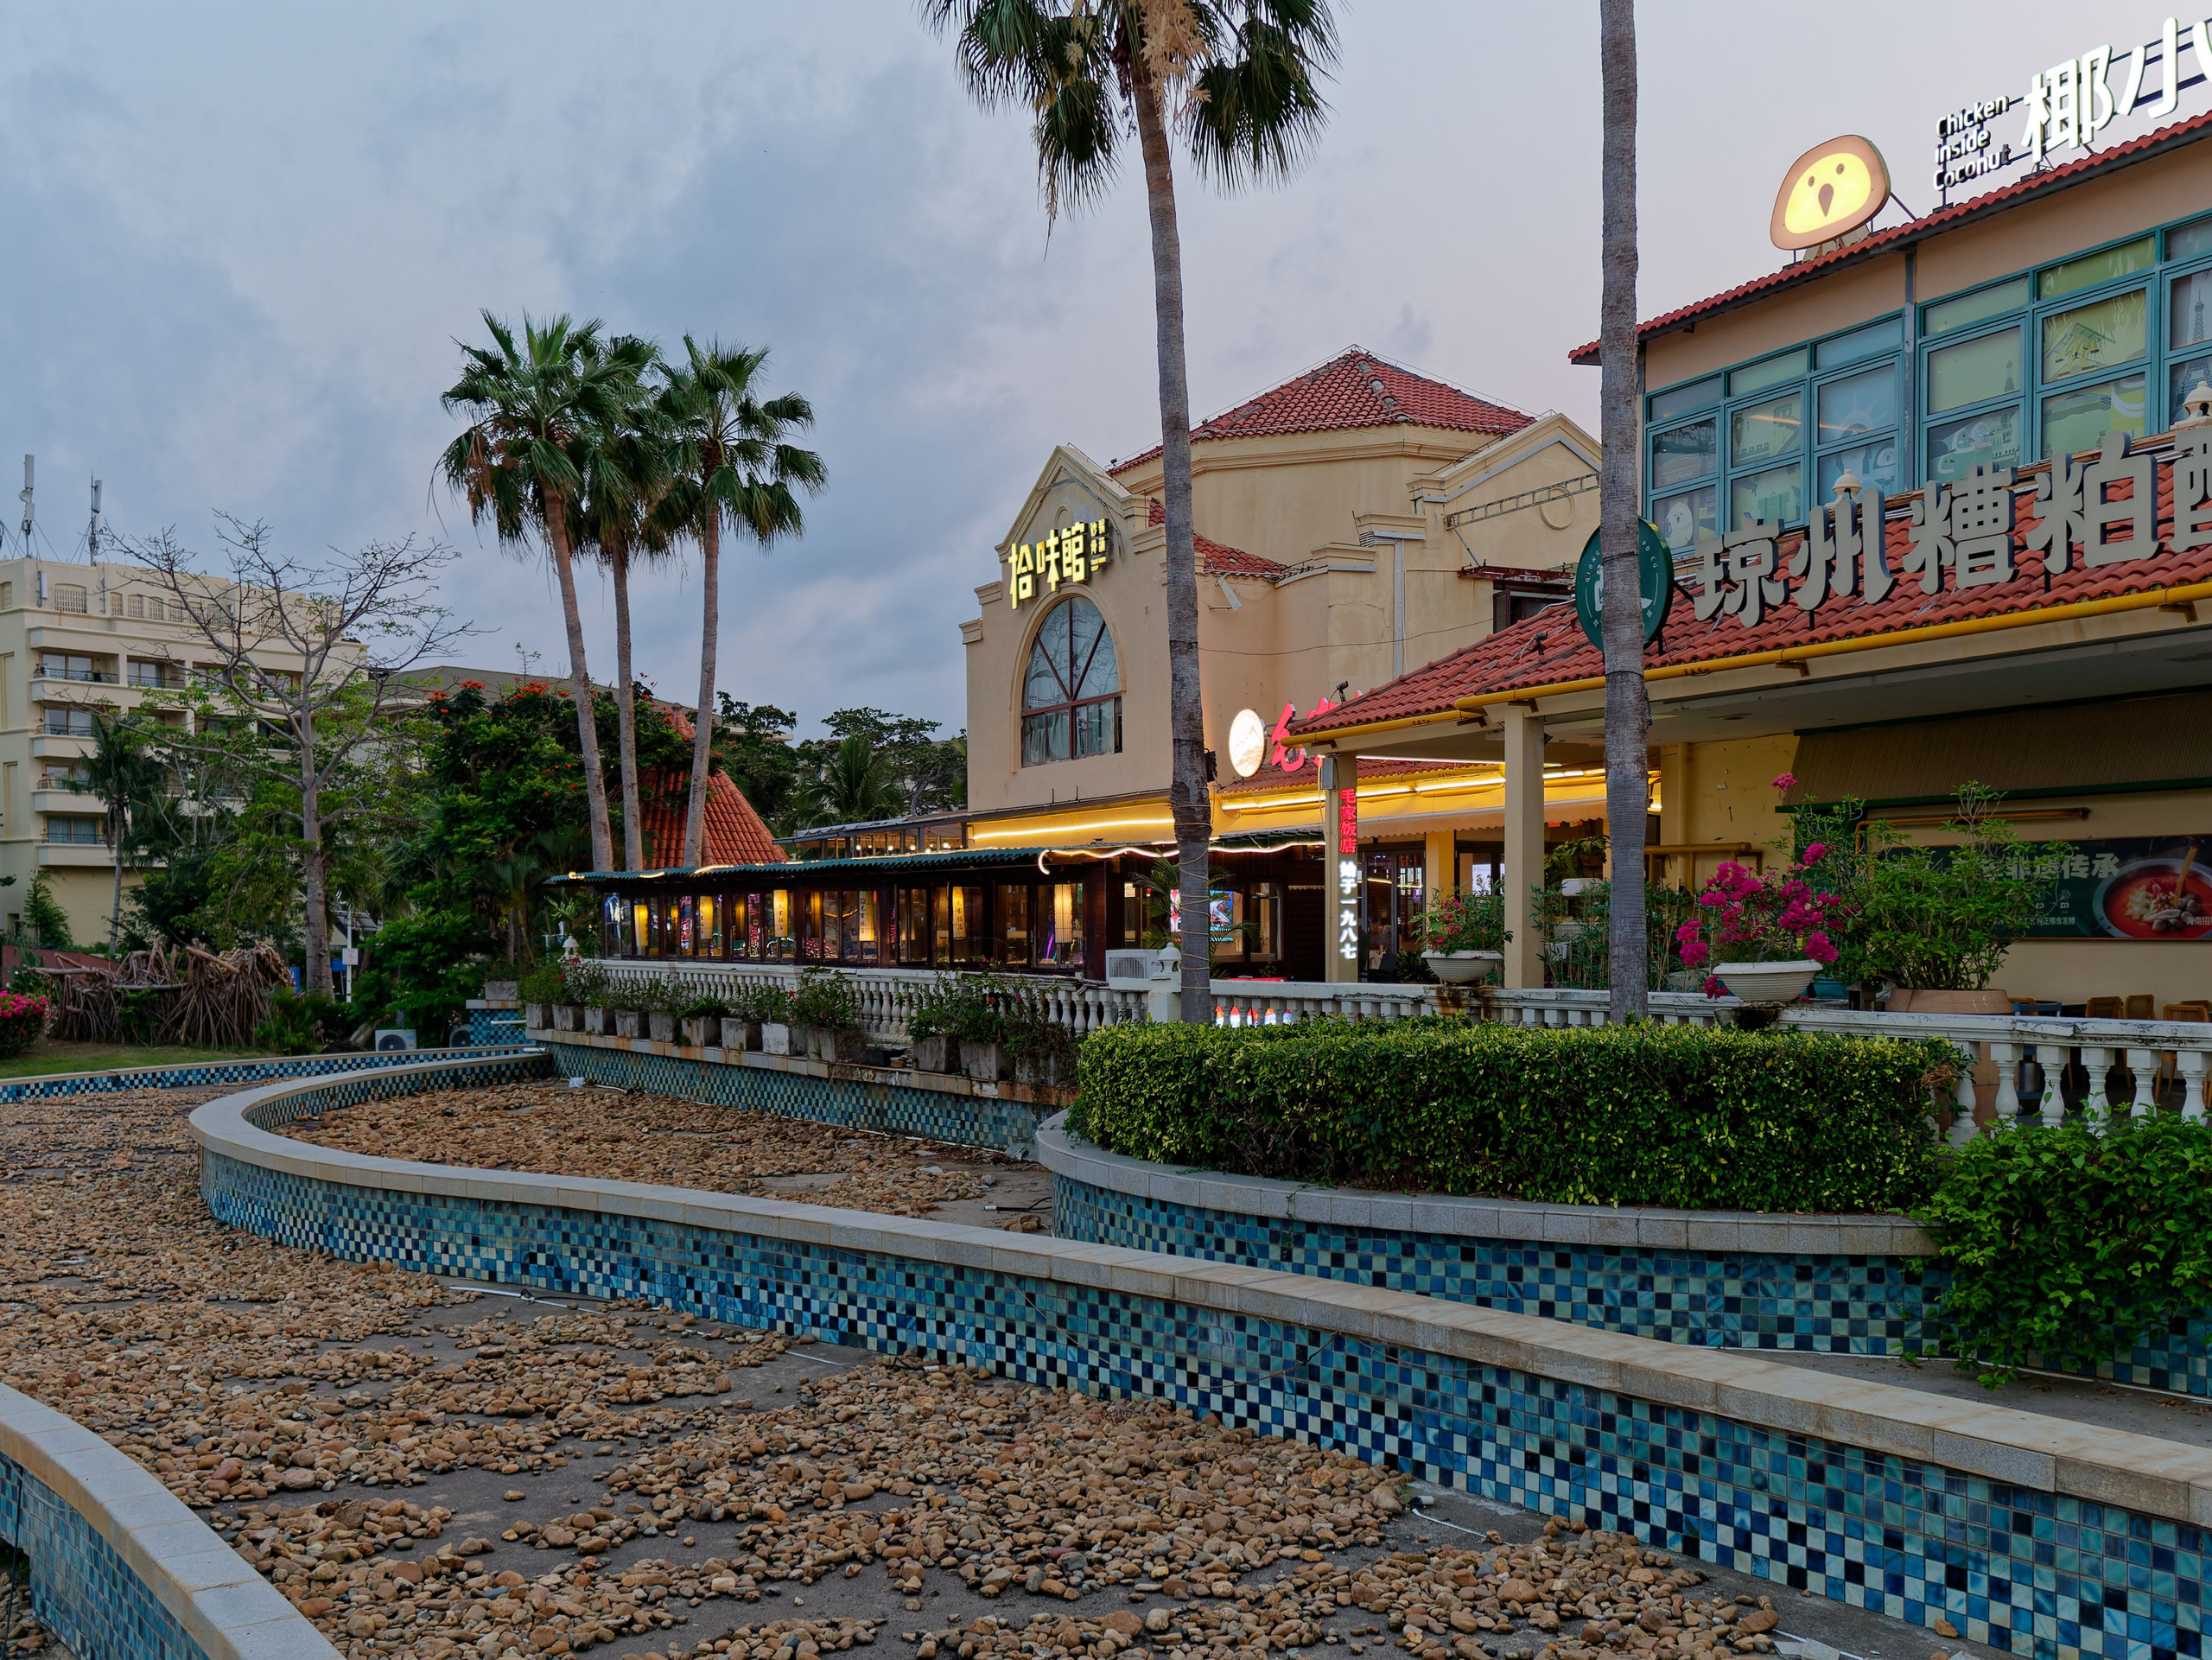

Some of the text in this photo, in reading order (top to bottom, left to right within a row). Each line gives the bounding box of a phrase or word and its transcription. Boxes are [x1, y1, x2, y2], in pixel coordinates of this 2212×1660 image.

[1936, 96, 2009, 138] Chicken
[1933, 143, 2011, 192] Coconut
[1935, 129, 1991, 164] inside
[1641, 540, 1650, 551] PO
[1650, 556, 1658, 569] CU
[1339, 788, 1357, 855] 毛家饭店
[1339, 861, 1358, 961] 始于一九八七
[2186, 916, 2212, 926] 海南招
